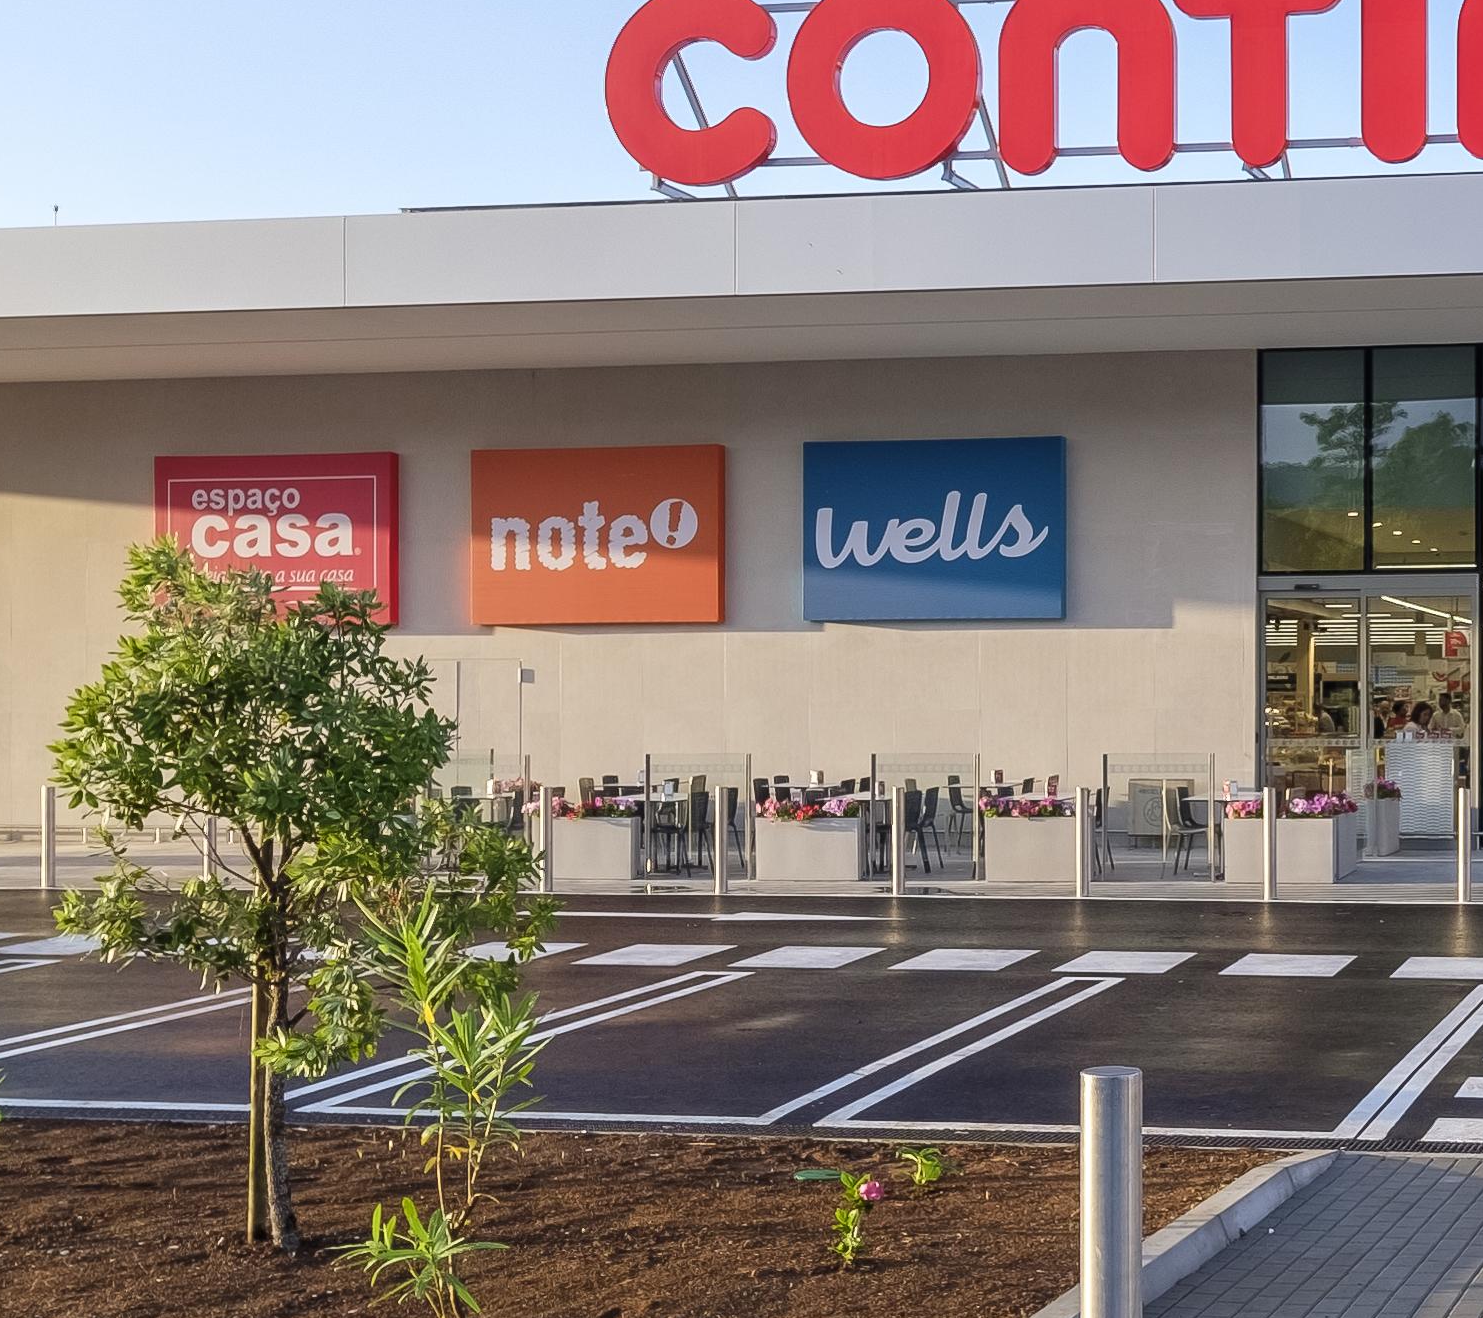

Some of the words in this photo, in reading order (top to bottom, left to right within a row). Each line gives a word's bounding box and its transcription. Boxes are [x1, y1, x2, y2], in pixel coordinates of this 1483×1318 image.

[191, 487, 301, 516] espaço
[191, 512, 354, 559] casa
[814, 490, 1050, 569] wells
[275, 570, 285, 583] a
[289, 569, 316, 583] sua
[319, 568, 355, 583] casa
